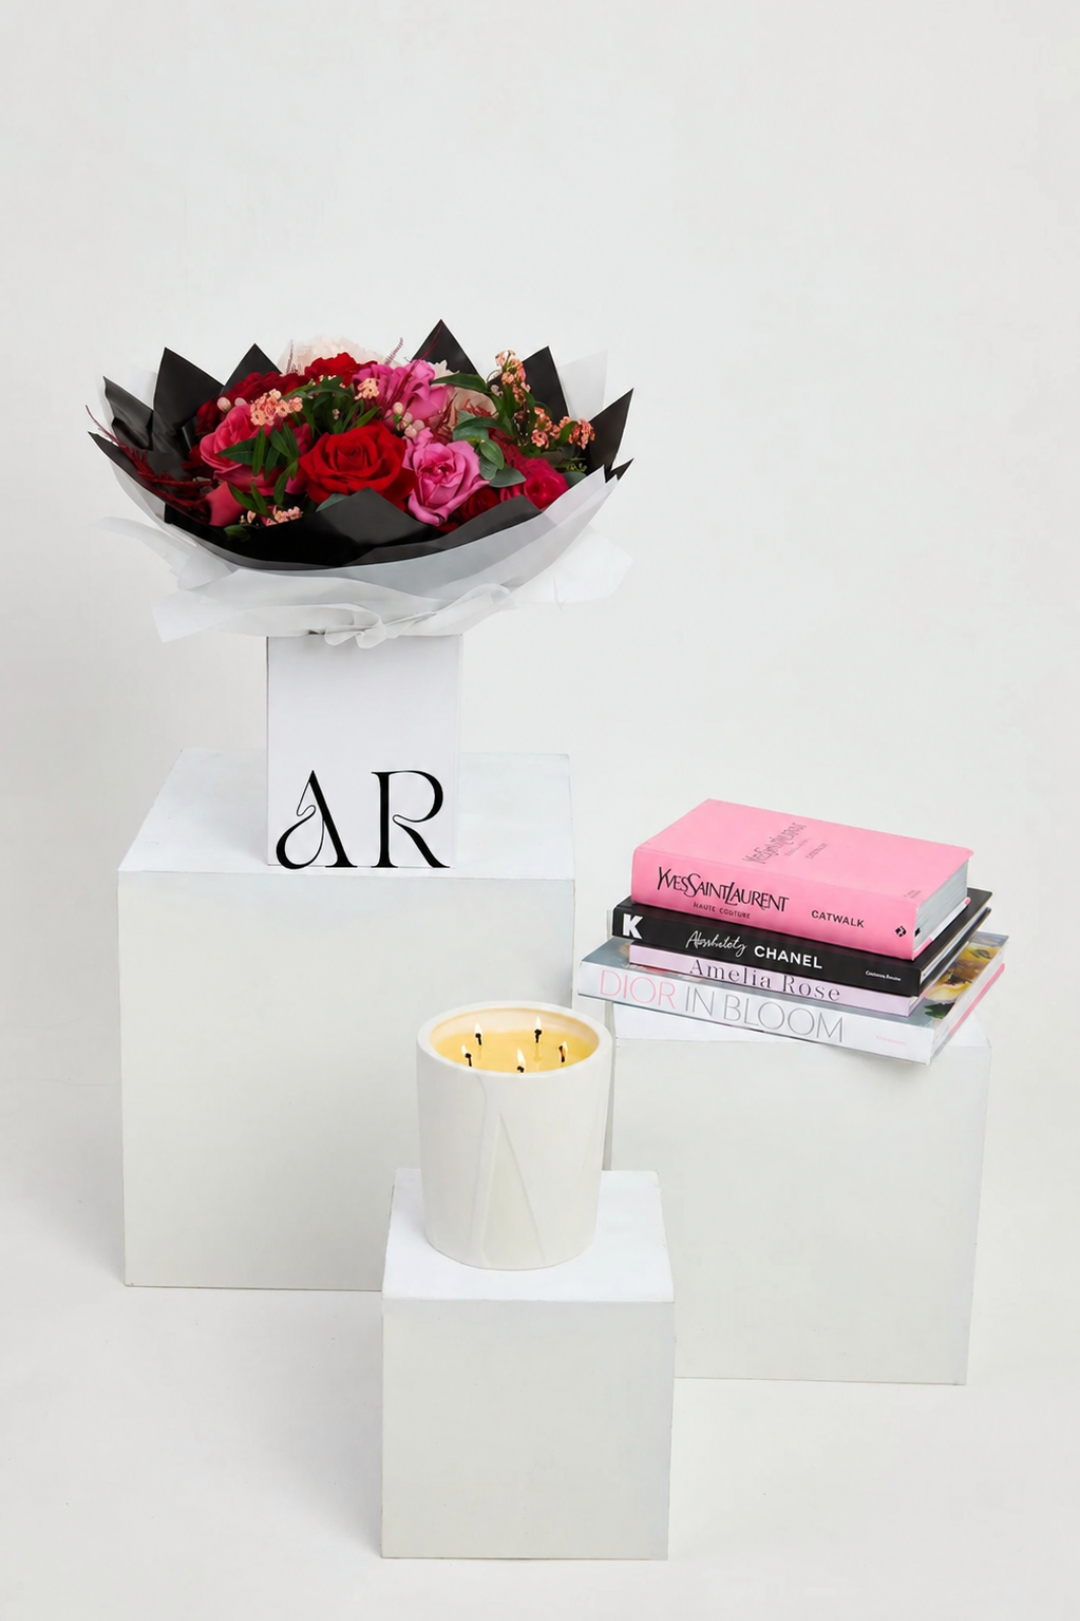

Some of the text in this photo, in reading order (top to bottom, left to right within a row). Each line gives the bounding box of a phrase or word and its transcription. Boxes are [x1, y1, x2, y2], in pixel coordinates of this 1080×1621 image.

[622, 913, 644, 940] K
[811, 909, 865, 929] CATWALK
[754, 945, 823, 970] CHANEL
[689, 958, 772, 990] Amelia
[782, 974, 841, 1002] Rose
[599, 969, 844, 1043] DIOR IN BLOOM
